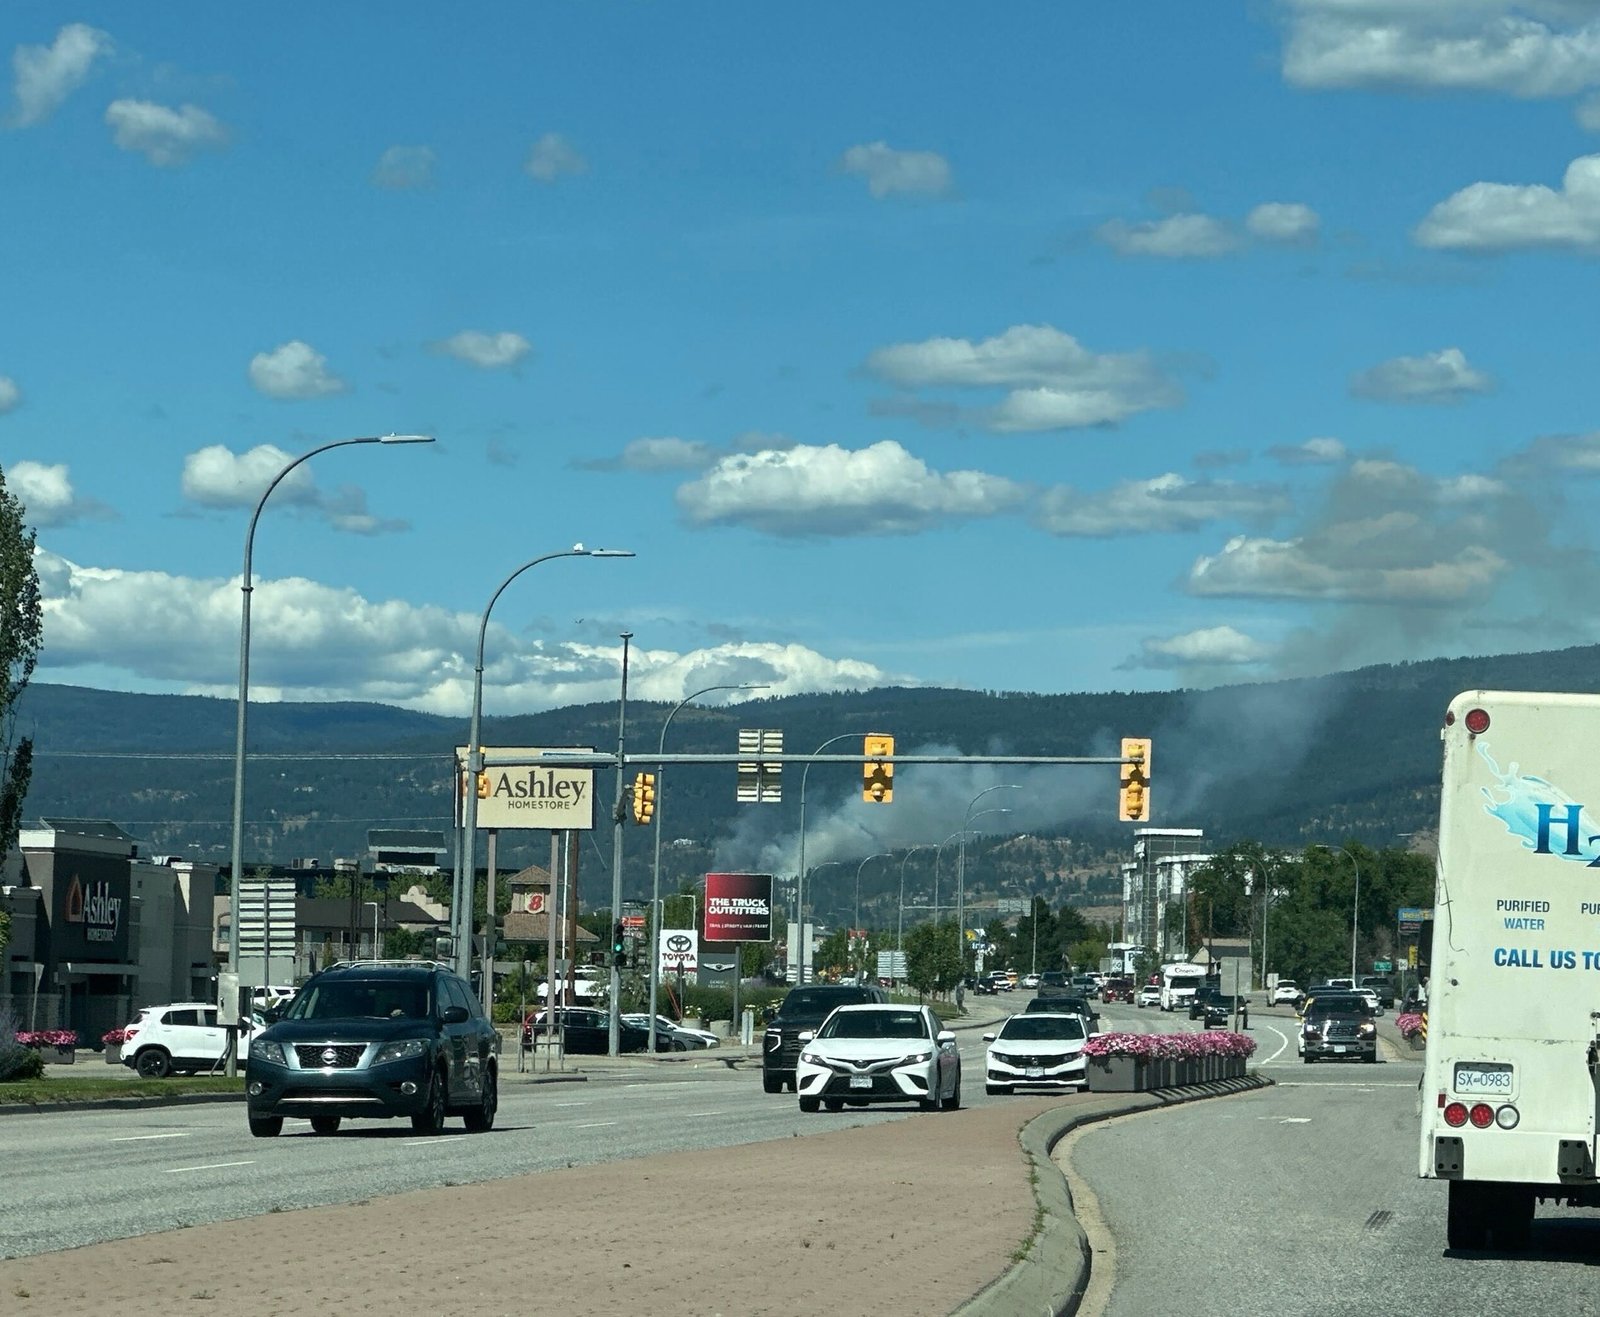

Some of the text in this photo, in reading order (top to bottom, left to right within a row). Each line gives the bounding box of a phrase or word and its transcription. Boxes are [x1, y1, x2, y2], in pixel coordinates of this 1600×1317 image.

[493, 770, 586, 806] Ashley
[508, 801, 570, 809] HOMESTORE
[82, 881, 121, 936] Ashley
[529, 895, 543, 910] 8
[709, 898, 766, 907] THE TRUCK
[1496, 899, 1550, 913] PURIFIED
[708, 906, 769, 915] OUTFITTERS
[1504, 917, 1545, 931] WATER
[662, 952, 697, 961] TOYOTA
[1494, 948, 1543, 968] CALL
[1550, 950, 1576, 969] US
